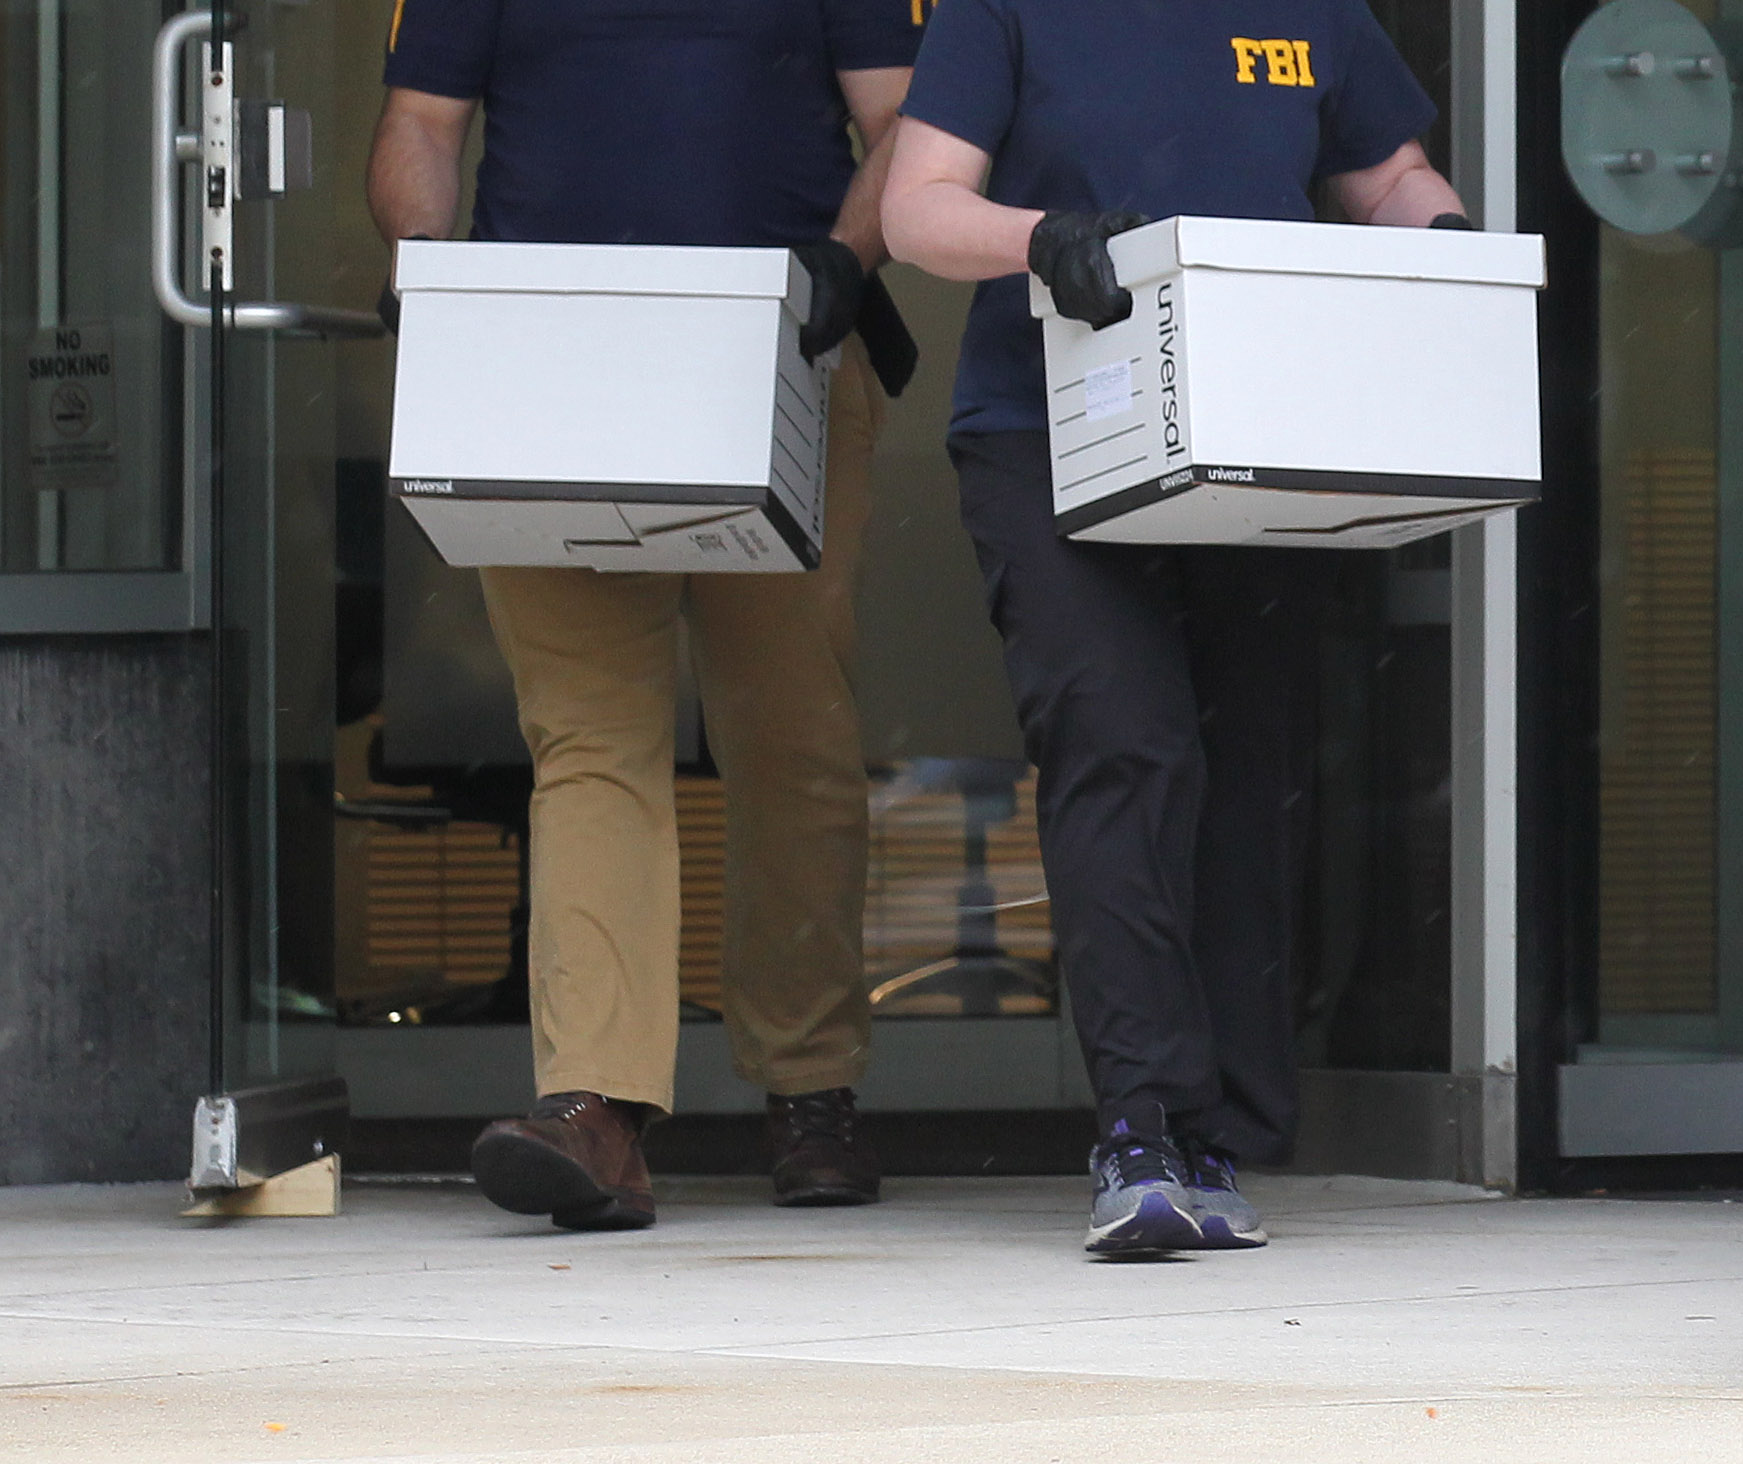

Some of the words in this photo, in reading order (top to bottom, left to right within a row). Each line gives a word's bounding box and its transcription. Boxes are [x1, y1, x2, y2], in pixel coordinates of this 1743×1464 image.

[1230, 36, 1317, 87] FBI
[55, 329, 82, 351] NO
[27, 353, 112, 380] SMOKING
[1157, 282, 1187, 459] universal
